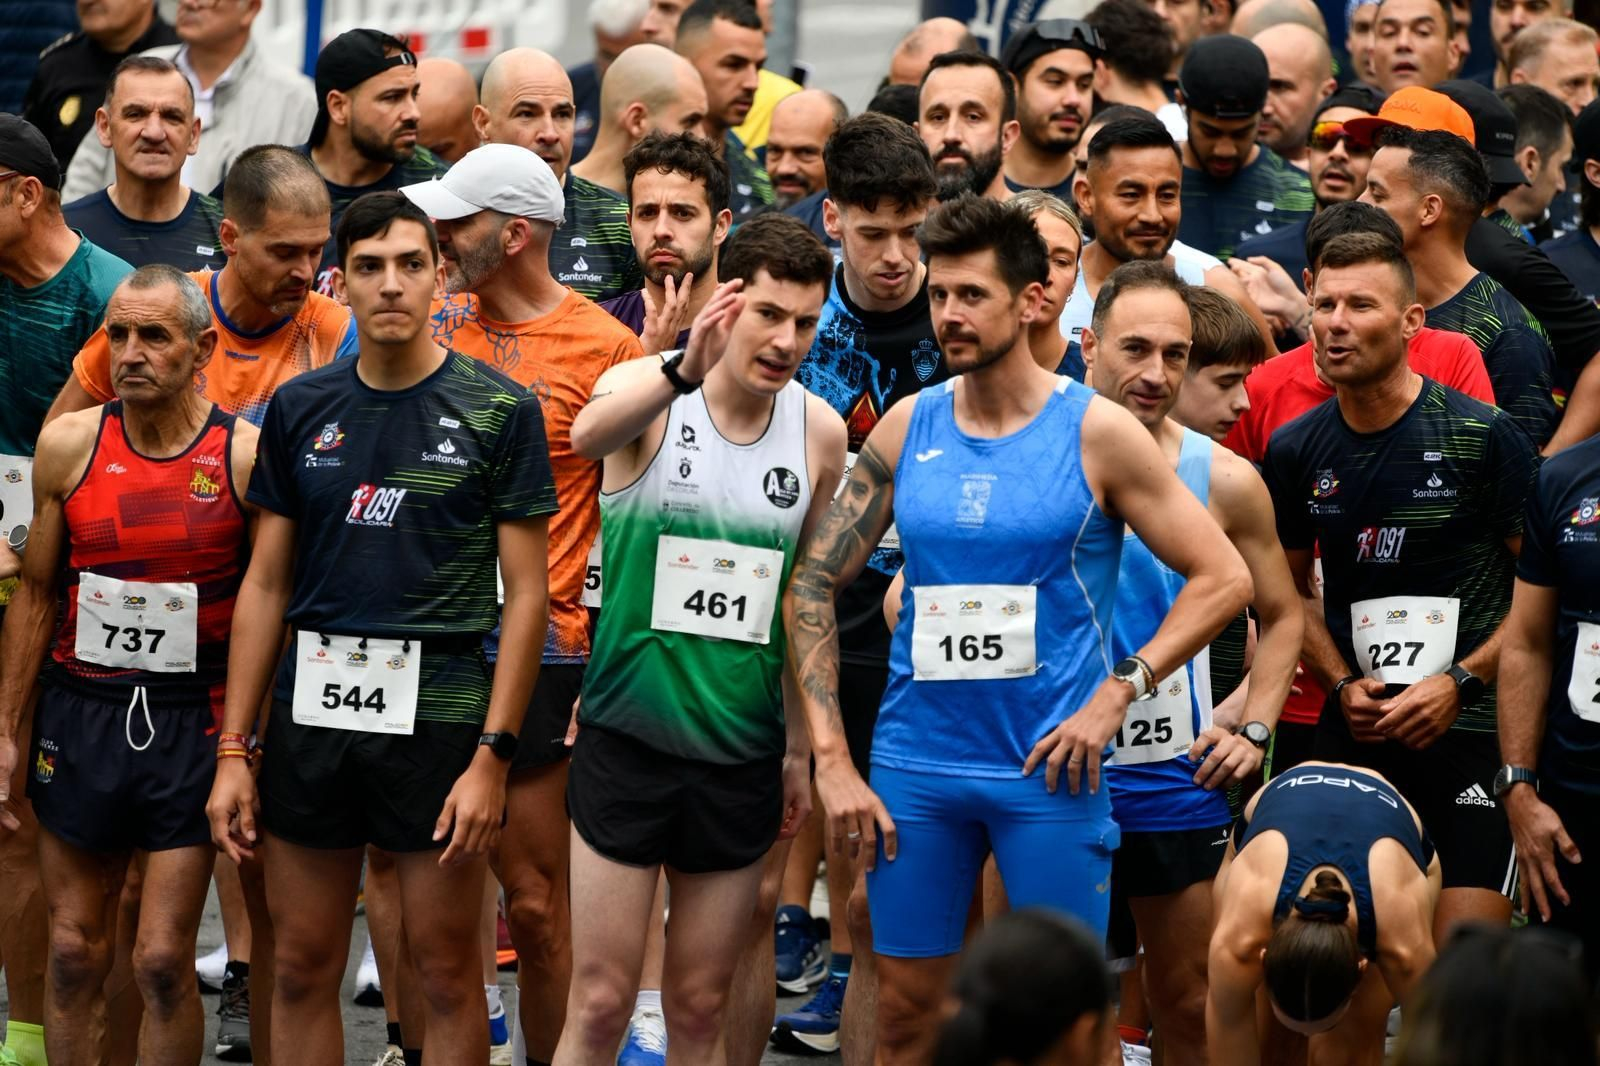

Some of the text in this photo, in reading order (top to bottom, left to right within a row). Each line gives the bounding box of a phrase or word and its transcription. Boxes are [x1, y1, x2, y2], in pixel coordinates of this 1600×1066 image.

[558, 272, 602, 282] Santander
[421, 451, 469, 466] Santander
[1412, 489, 1458, 498] Santander
[683, 589, 747, 622] 461
[102, 622, 166, 654] 737
[938, 634, 1004, 662] 165
[1368, 641, 1425, 671] 227
[321, 683, 386, 714] 544
[1115, 716, 1173, 748] 125
[1277, 774, 1398, 808] CAPOL
[1455, 796, 1496, 808] adidas
